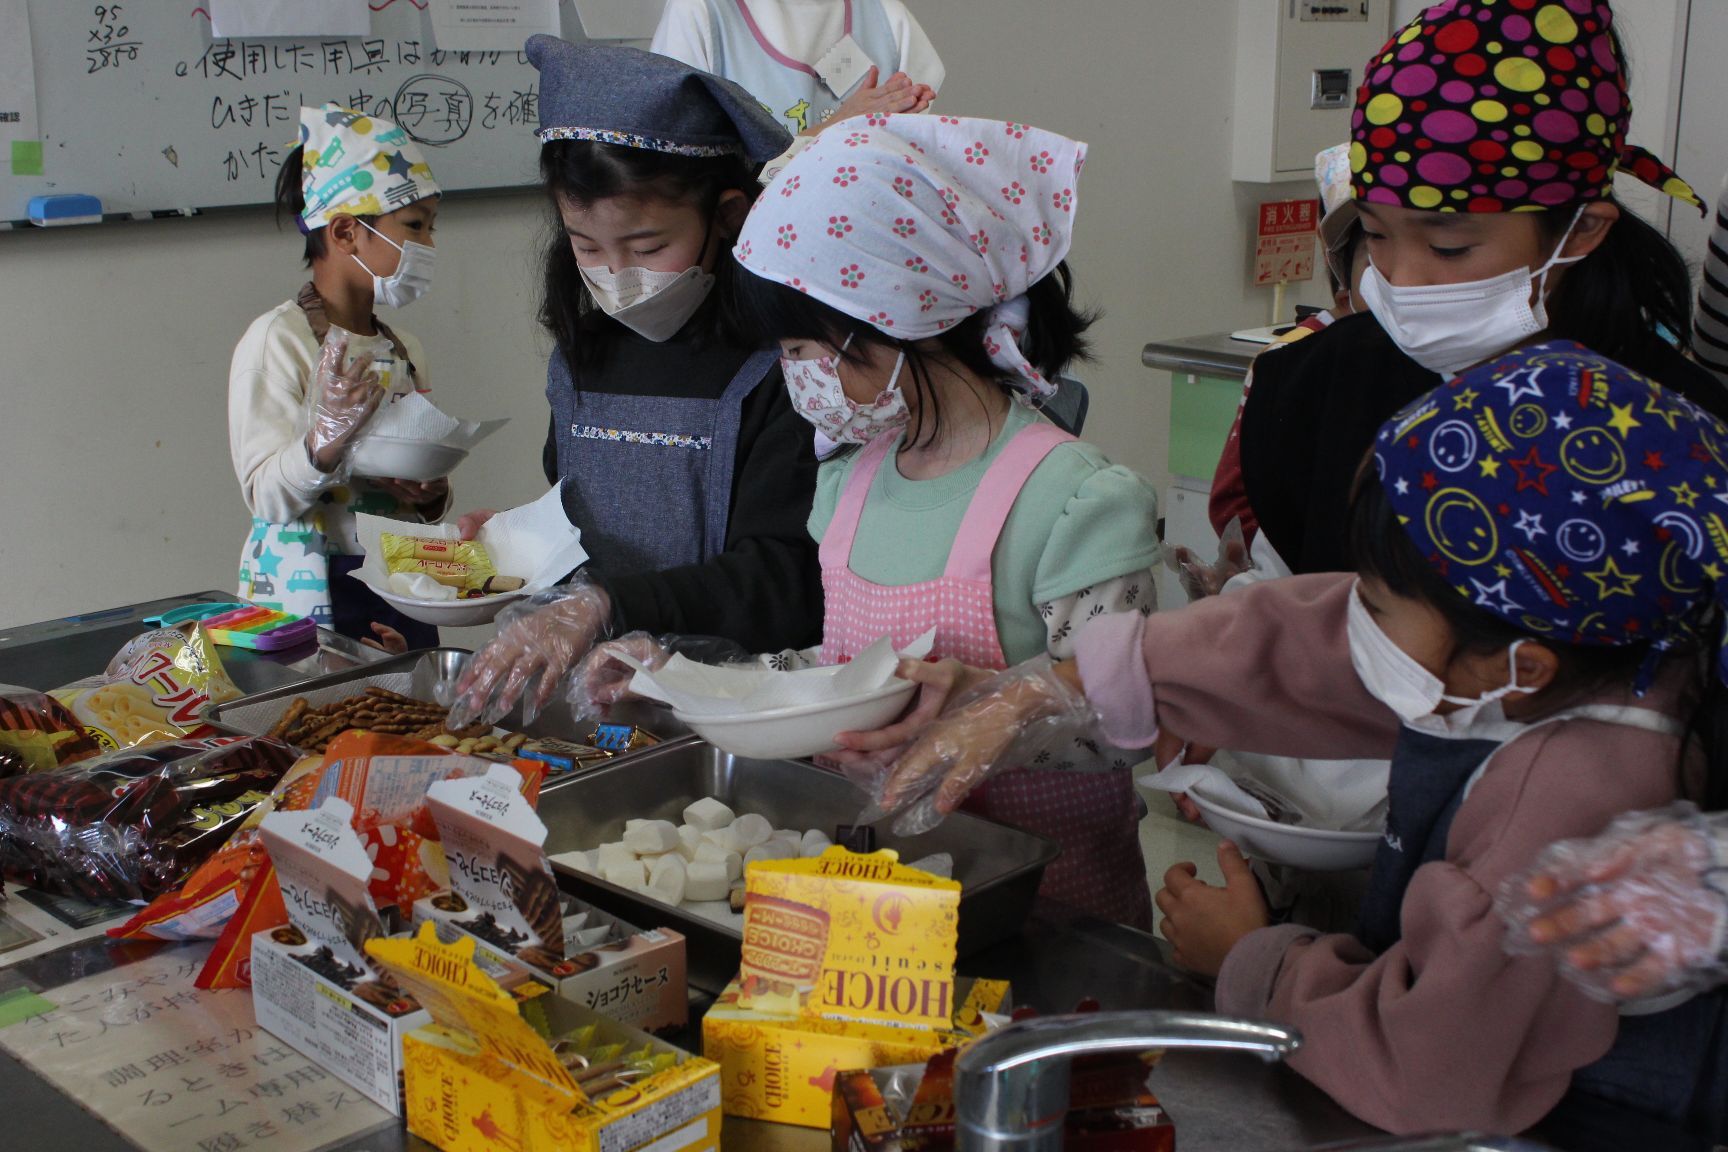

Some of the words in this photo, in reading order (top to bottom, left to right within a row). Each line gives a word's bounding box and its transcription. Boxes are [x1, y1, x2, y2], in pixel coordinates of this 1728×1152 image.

[95, 5, 122, 24] 95
[87, 47, 139, 73] 2850
[1265, 203, 1311, 225] 消火器
[817, 861, 892, 880] CHOICE
[413, 945, 468, 986] CHOICE
[586, 967, 668, 1010] ショコラセーヌ
[765, 1042, 782, 1108] CHOICE
[441, 1071, 459, 1142] CHOICE
